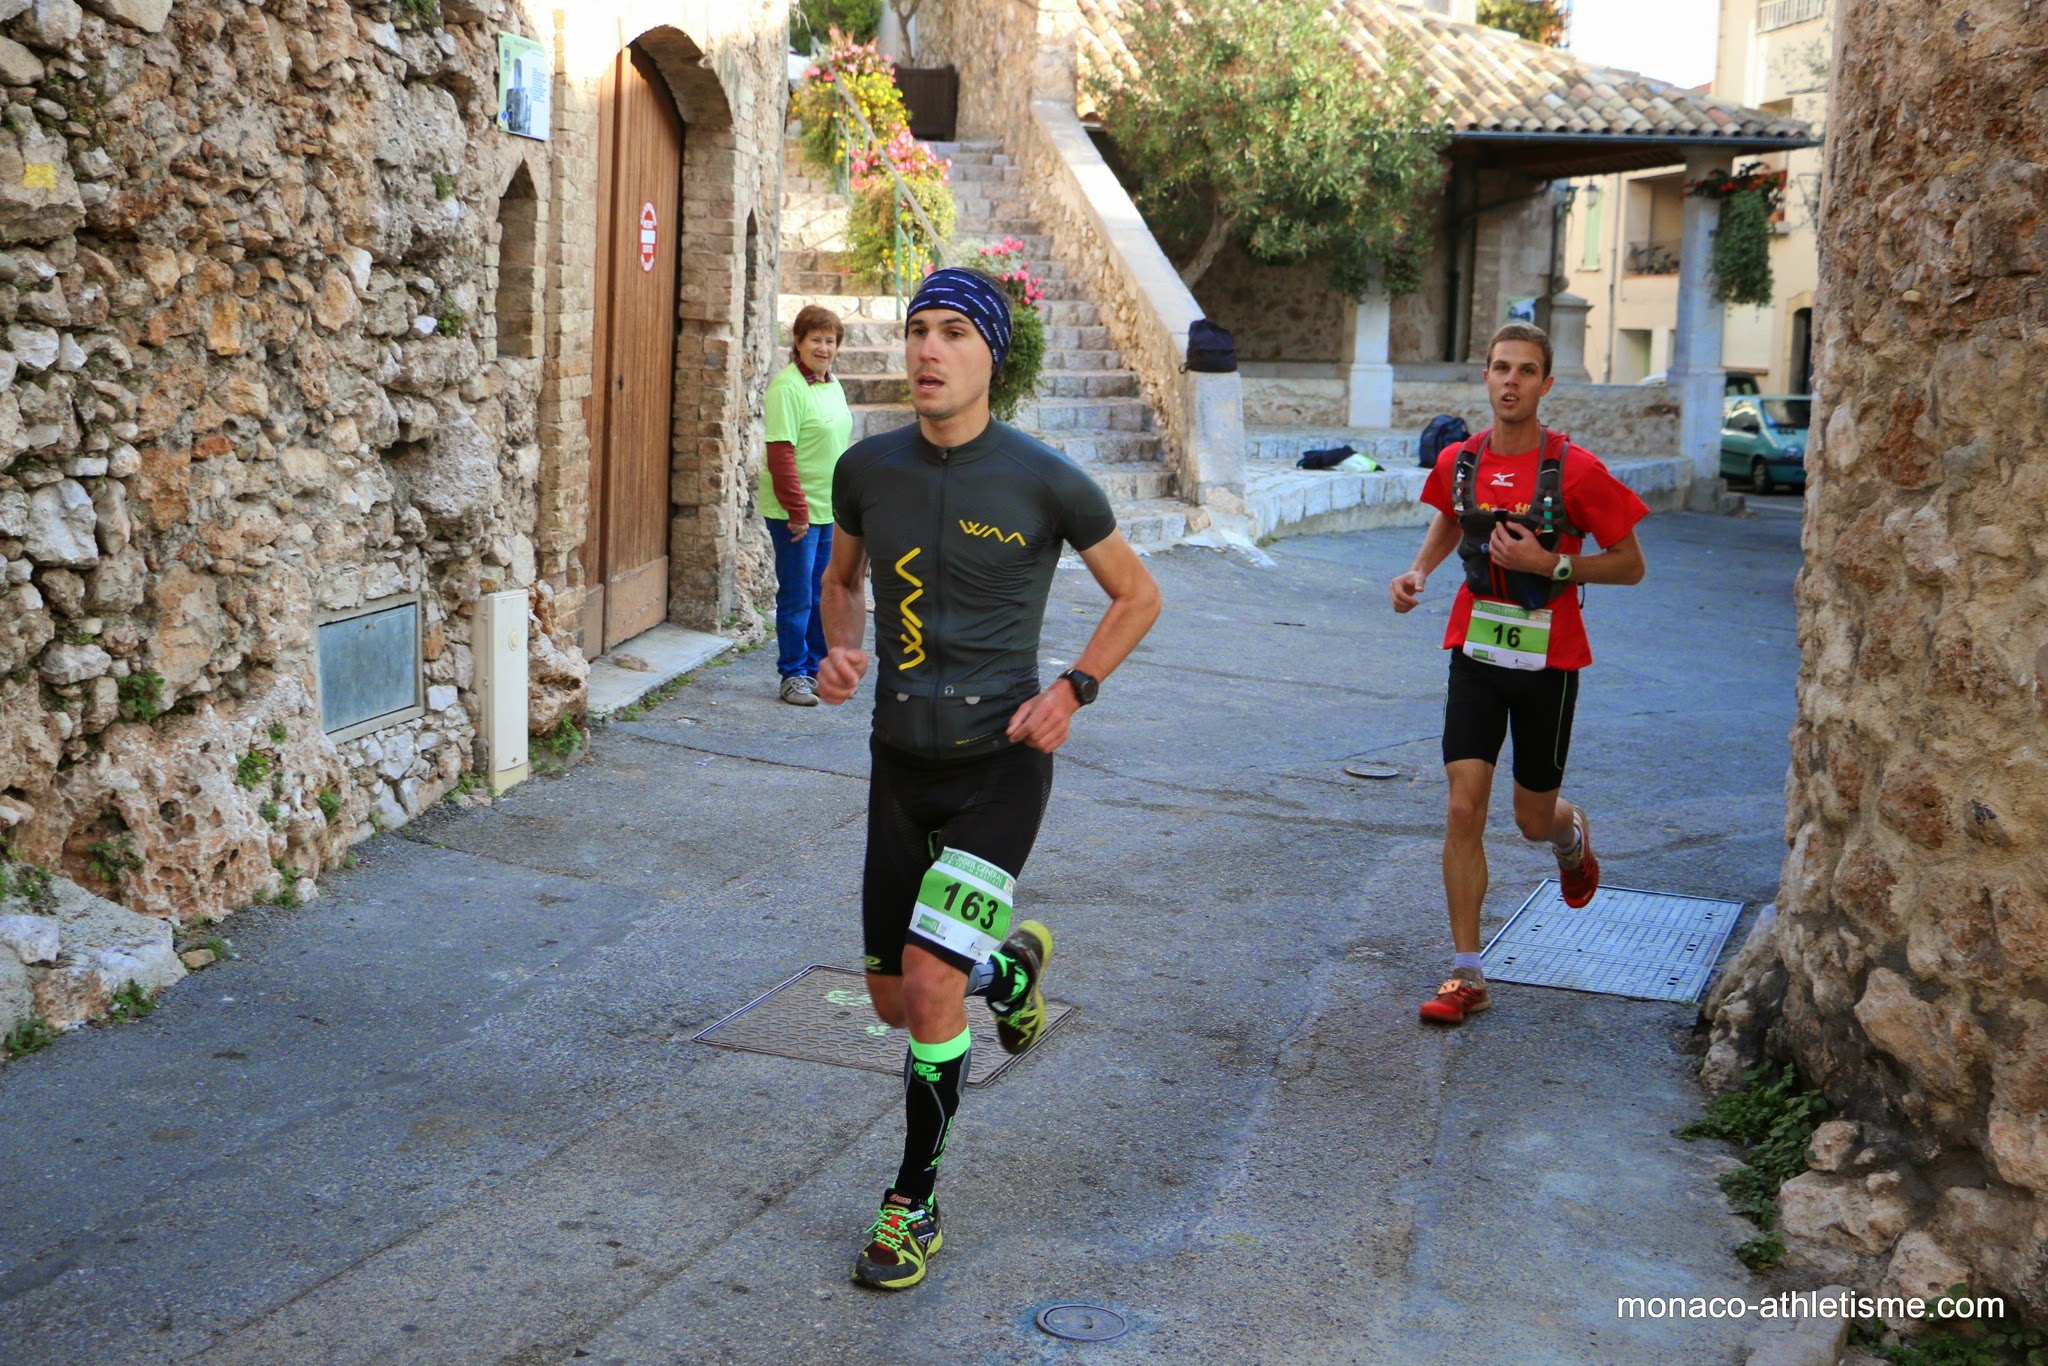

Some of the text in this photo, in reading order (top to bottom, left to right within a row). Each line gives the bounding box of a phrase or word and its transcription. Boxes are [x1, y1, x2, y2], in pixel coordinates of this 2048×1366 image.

[1493, 623, 1522, 648] 16
[950, 853, 977, 869] CONSEIL
[943, 882, 999, 930] 163
